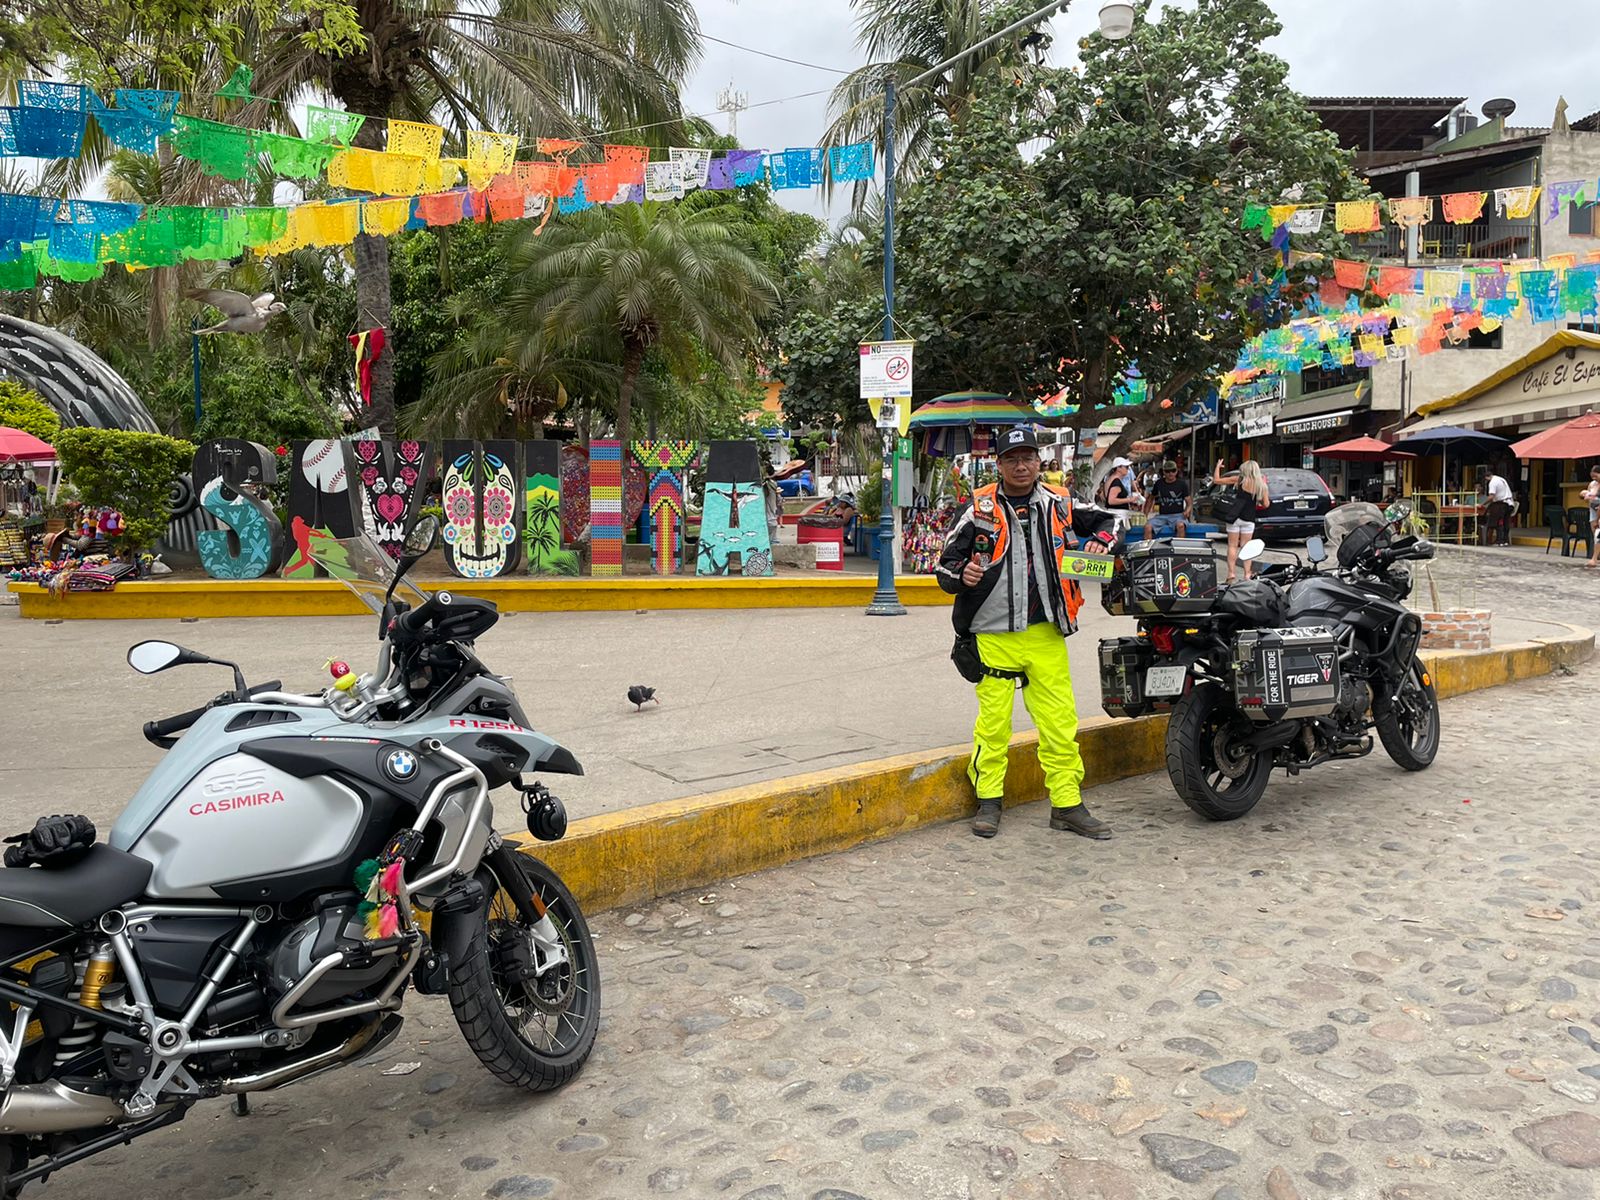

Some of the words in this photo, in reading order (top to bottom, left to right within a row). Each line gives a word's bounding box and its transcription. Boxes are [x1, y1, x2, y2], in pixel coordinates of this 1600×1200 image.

[871, 345, 881, 354] NO
[1522, 371, 1549, 393] Café
[1553, 364, 1569, 386] El
[1286, 421, 1310, 434] PUBLIC
[1310, 417, 1337, 431] HOUSE
[1086, 563, 1106, 574] RRM
[1267, 651, 1276, 669] RIDE
[1269, 670, 1277, 687] THE
[1287, 673, 1319, 685] TIGER
[1270, 687, 1279, 702] FOR
[449, 719, 466, 728] R
[469, 719, 523, 732] 1250
[203, 768, 266, 796] GS
[189, 790, 285, 816] CASIMIRA
